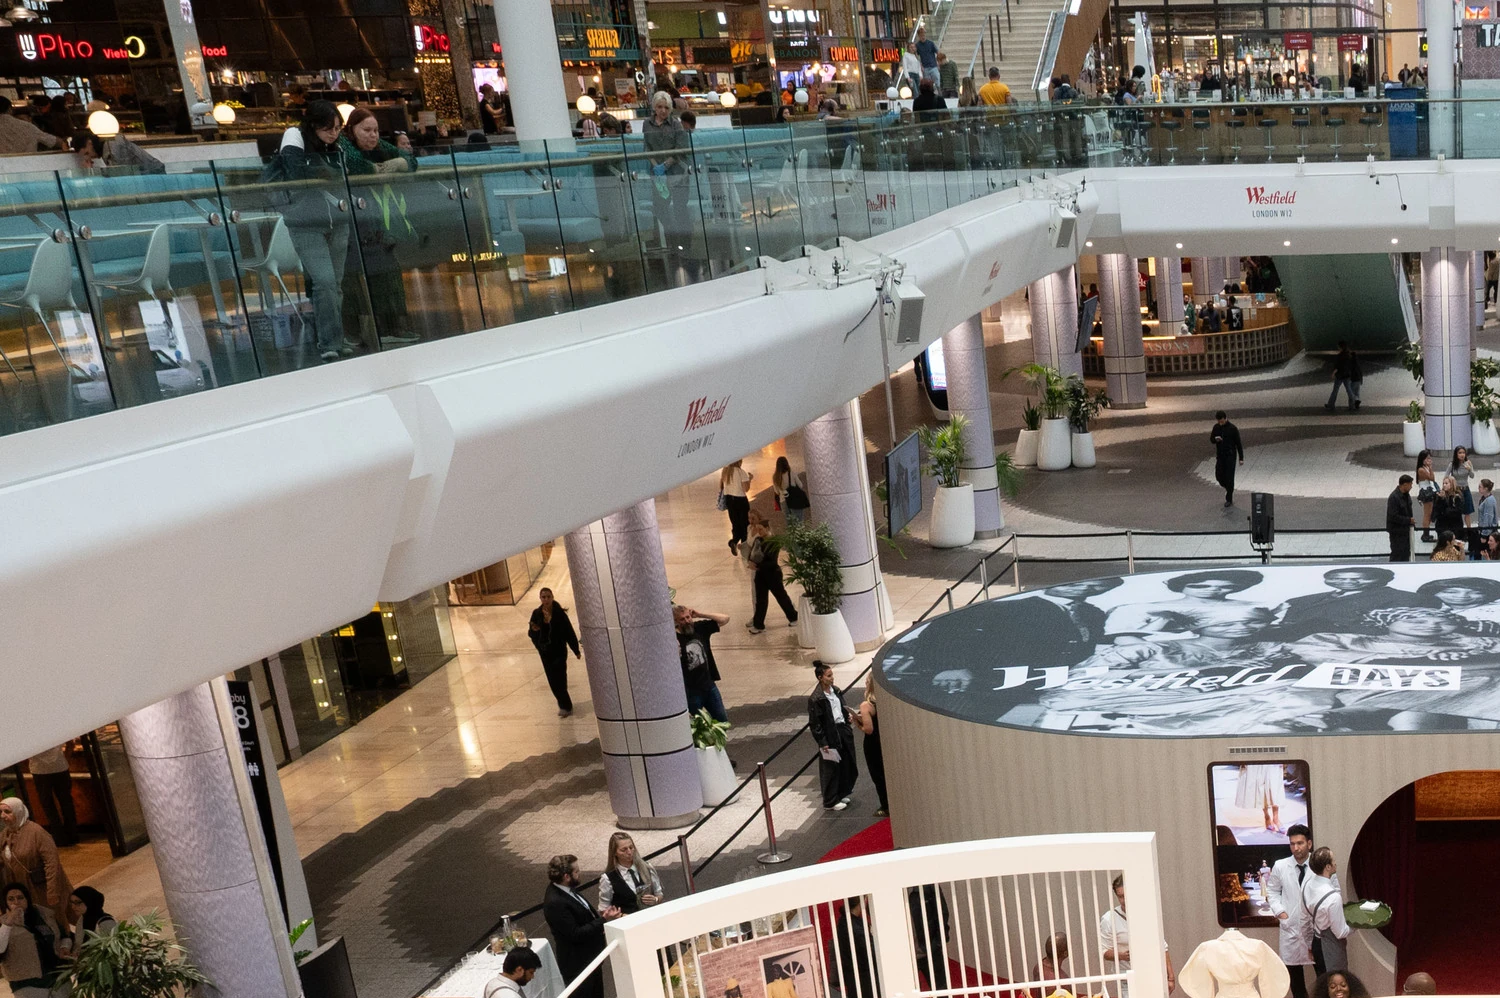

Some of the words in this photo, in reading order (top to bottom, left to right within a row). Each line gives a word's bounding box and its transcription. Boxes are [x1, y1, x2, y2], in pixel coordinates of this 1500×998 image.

[37, 33, 93, 59] Pho
[202, 45, 228, 57] food
[1245, 186, 1297, 205] Westfield
[1252, 210, 1279, 218] LONDON
[1280, 209, 1292, 218] W12
[682, 394, 732, 435] Westfield
[992, 664, 1307, 691] Westfield
[1329, 666, 1451, 689] DAYS
